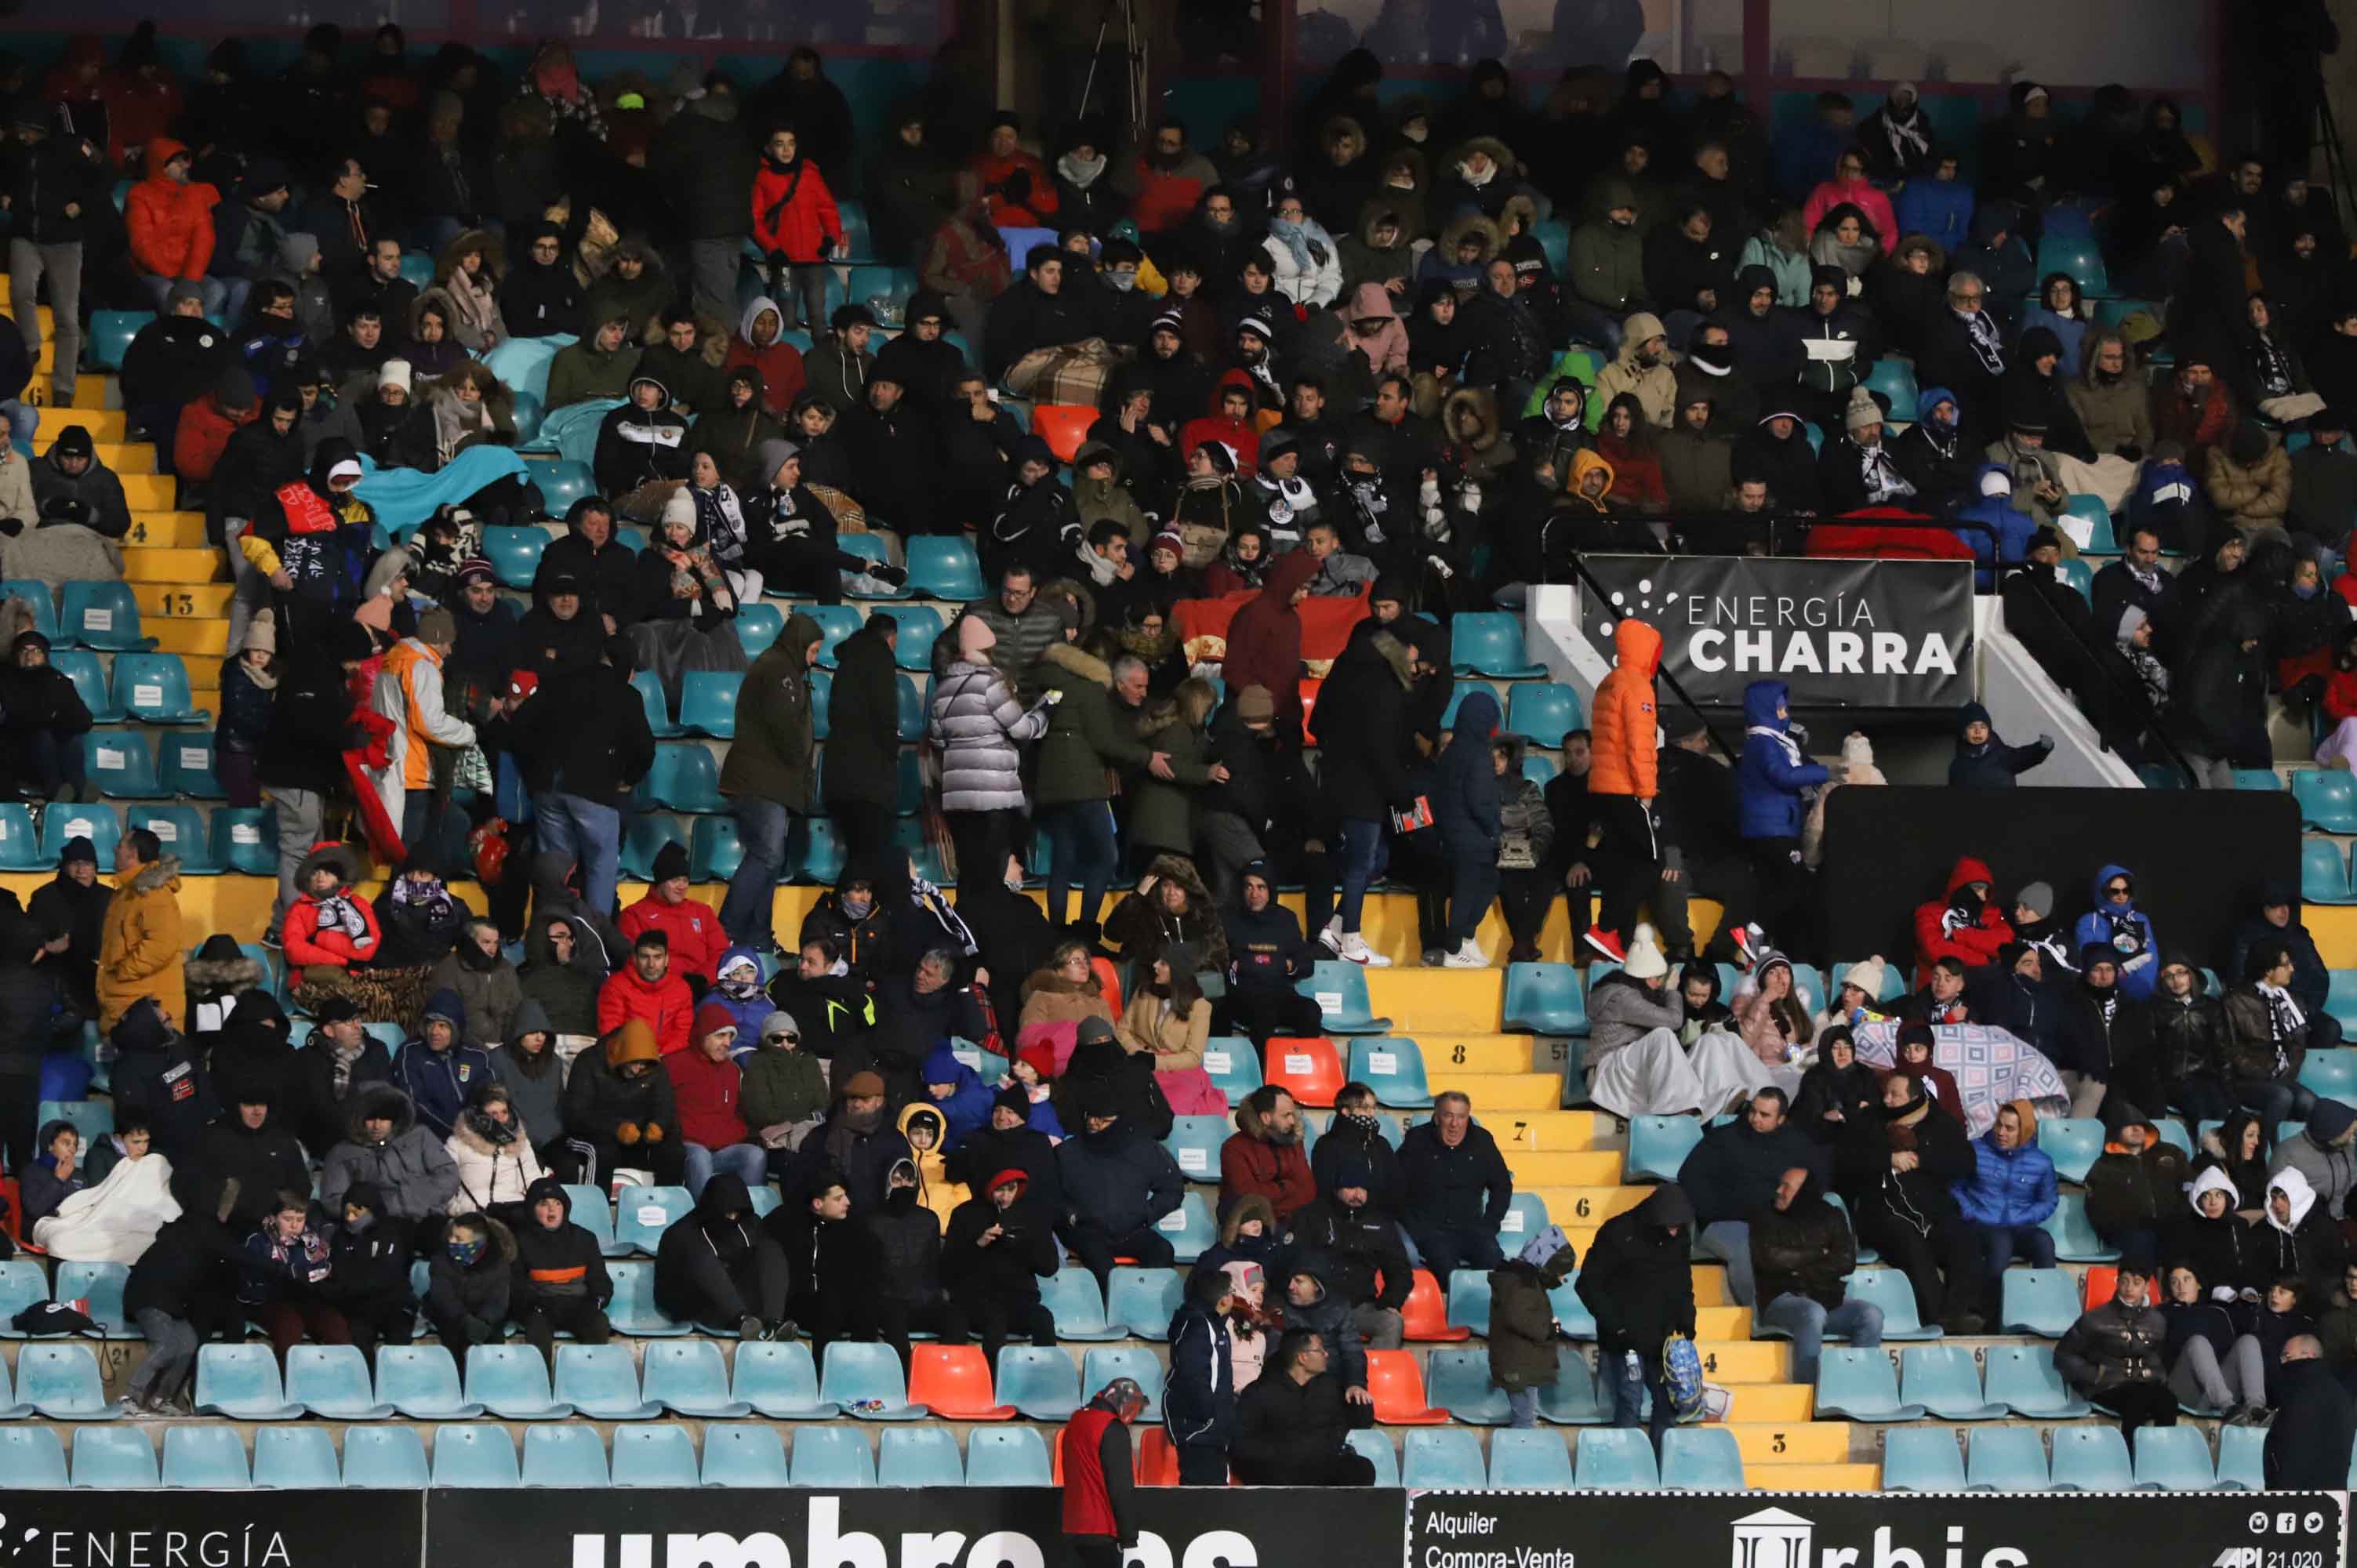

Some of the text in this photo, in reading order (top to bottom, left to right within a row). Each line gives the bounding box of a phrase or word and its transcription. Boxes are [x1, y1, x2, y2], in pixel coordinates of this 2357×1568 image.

[162, 593, 194, 615] 13
[1688, 591, 1876, 627] ENERGÍA
[1687, 629, 1957, 675] CHARRA
[1451, 1044, 1465, 1064] 8
[1513, 1121, 1527, 1141] 7
[1575, 1197, 1590, 1218] 6
[112, 1348, 131, 1365] 21
[1703, 1352, 1717, 1373] 4
[1772, 1433, 1786, 1454] 3
[1425, 1511, 1498, 1540] Alquiler
[52, 1523, 291, 1568] ENERGÍA
[1425, 1545, 1574, 1568] Compra-Venta
[2267, 1551, 2322, 1568] 21.020
